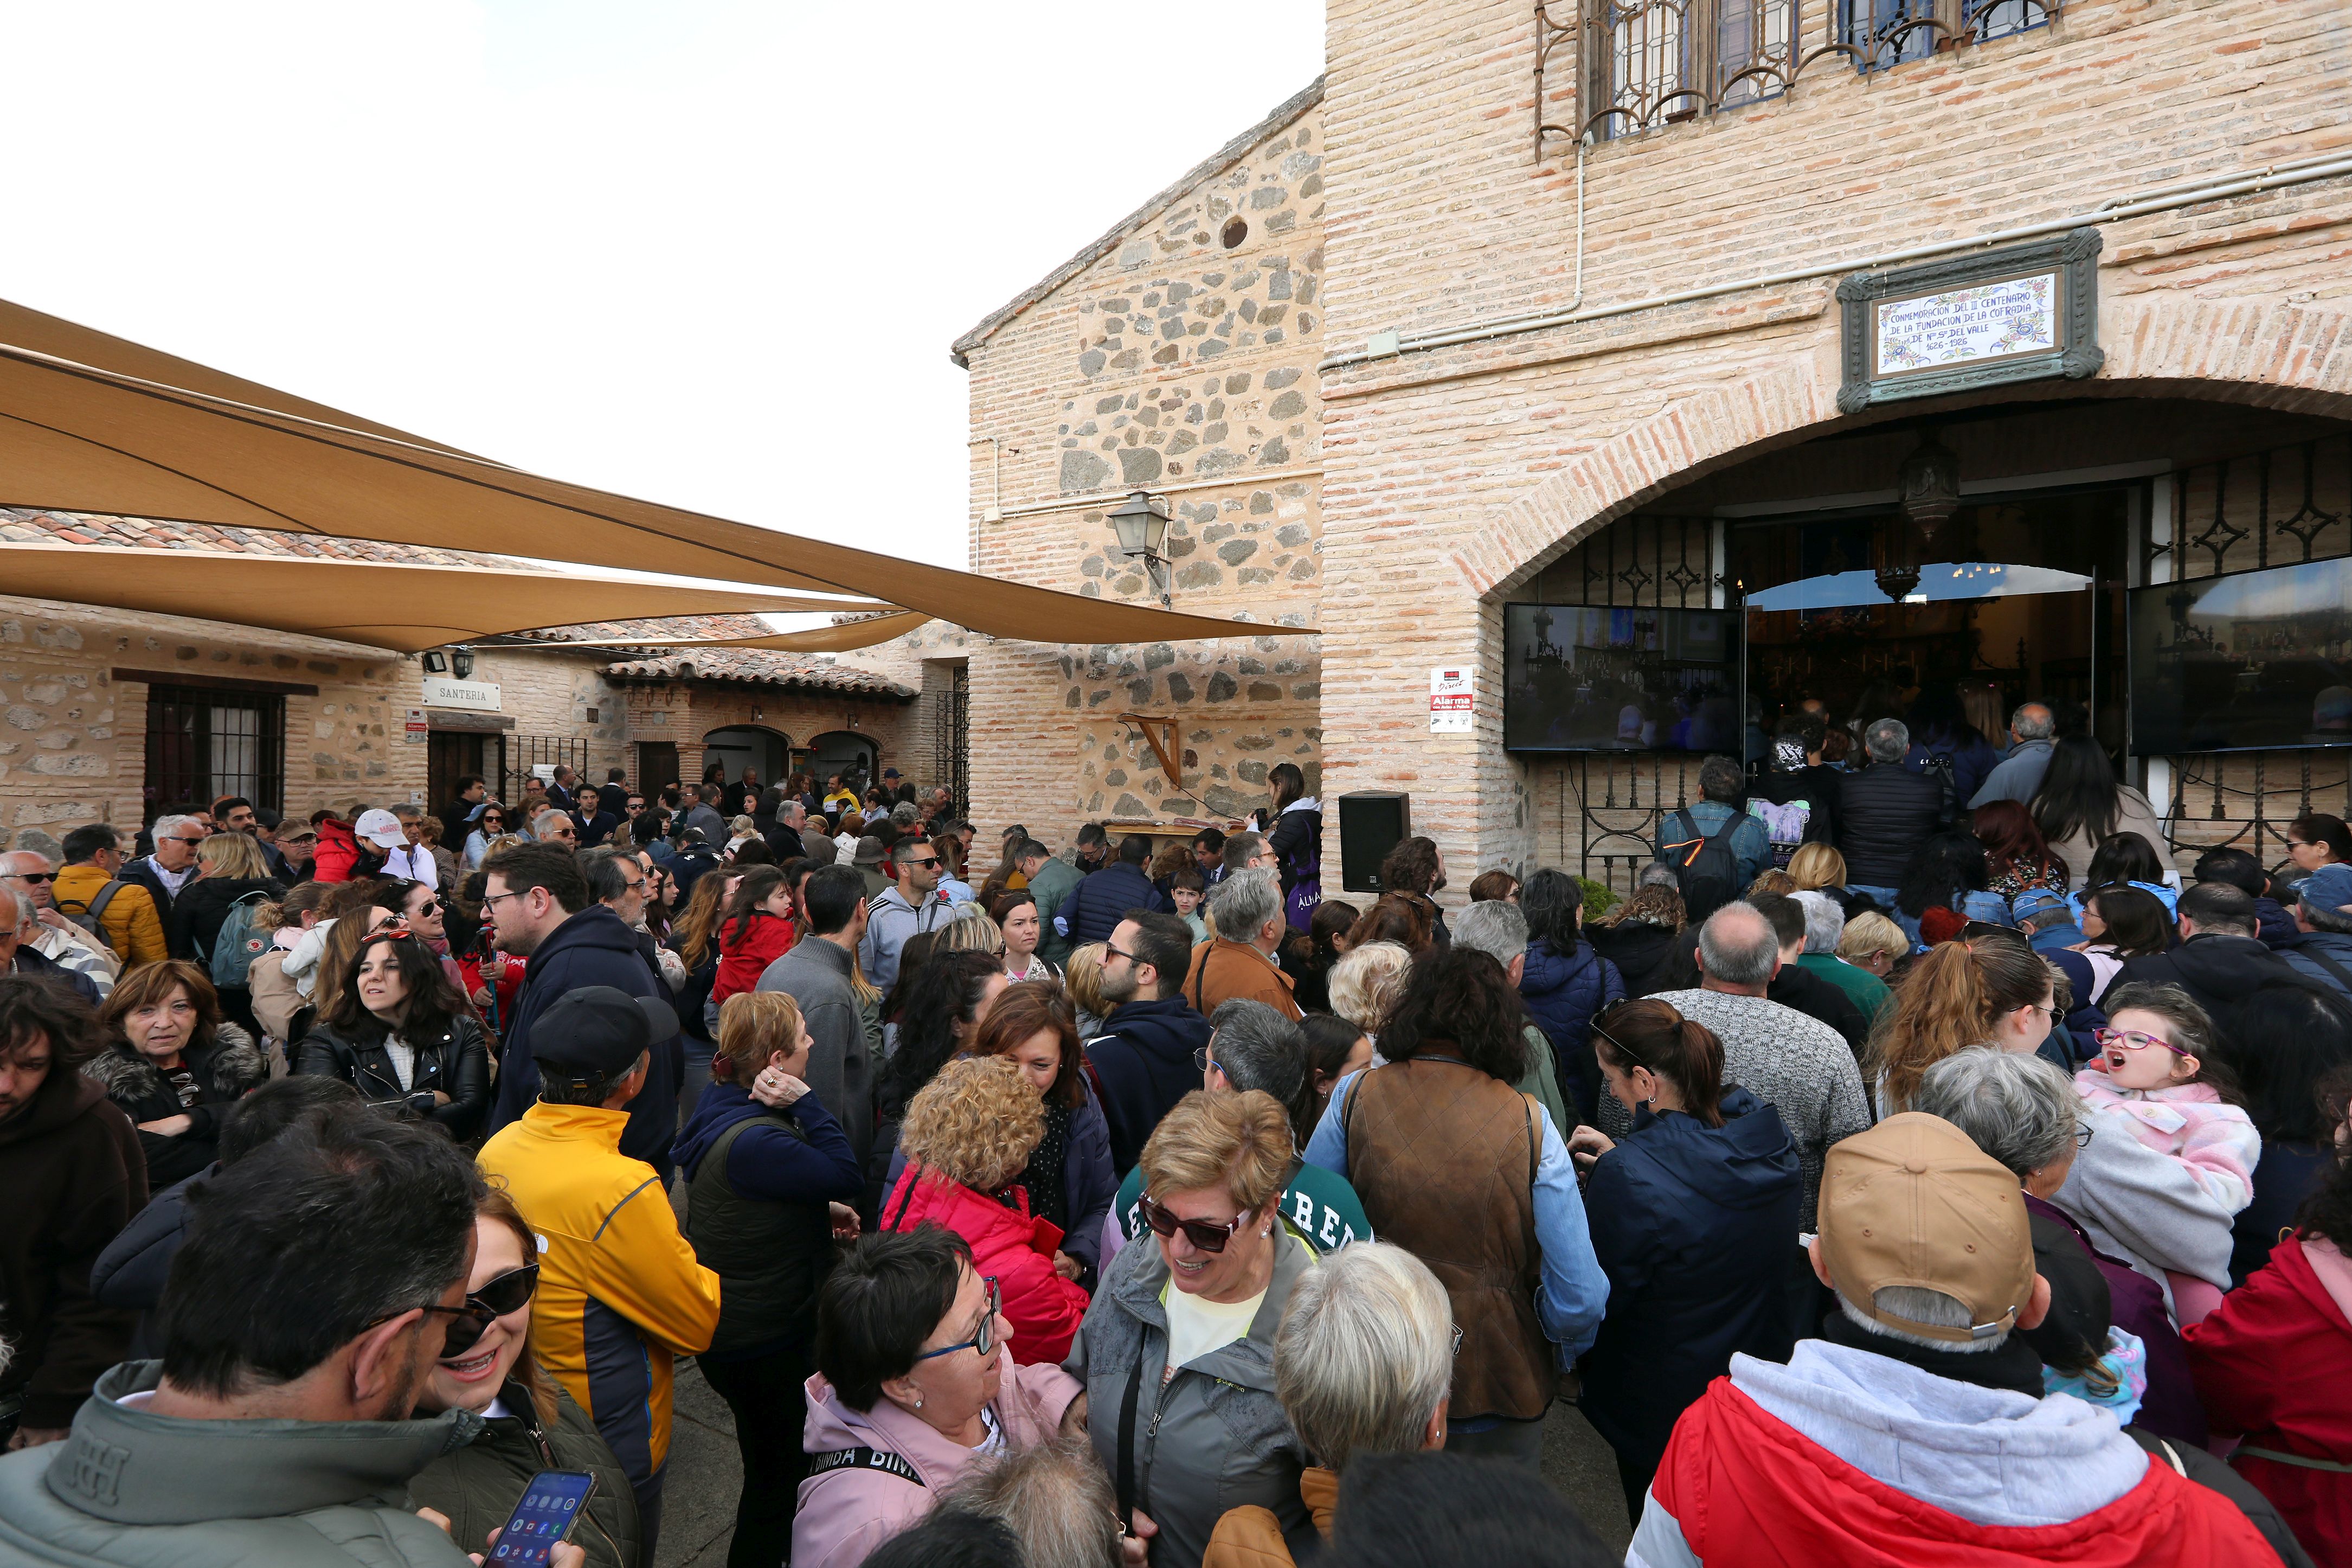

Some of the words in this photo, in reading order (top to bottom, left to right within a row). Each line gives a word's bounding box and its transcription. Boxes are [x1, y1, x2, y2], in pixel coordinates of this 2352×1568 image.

[1891, 306, 1949, 323] CONMEMORACION
[1952, 303, 1969, 313] DEL
[1981, 292, 2030, 307] CENTENARIO
[1890, 326, 1901, 335] DE
[1904, 324, 1913, 333] LA
[1916, 315, 1961, 331] FUNDACION
[1964, 312, 1975, 323] DE
[1977, 311, 1987, 320] LA
[1990, 304, 2032, 318] COFRADIA
[1910, 334, 1923, 344] DE
[1947, 328, 1965, 338] DEL
[1967, 324, 1989, 335] VALLE
[440, 687, 486, 701] SANTERIA
[1438, 679, 1466, 692] Direct
[1433, 696, 1470, 705] Alarma
